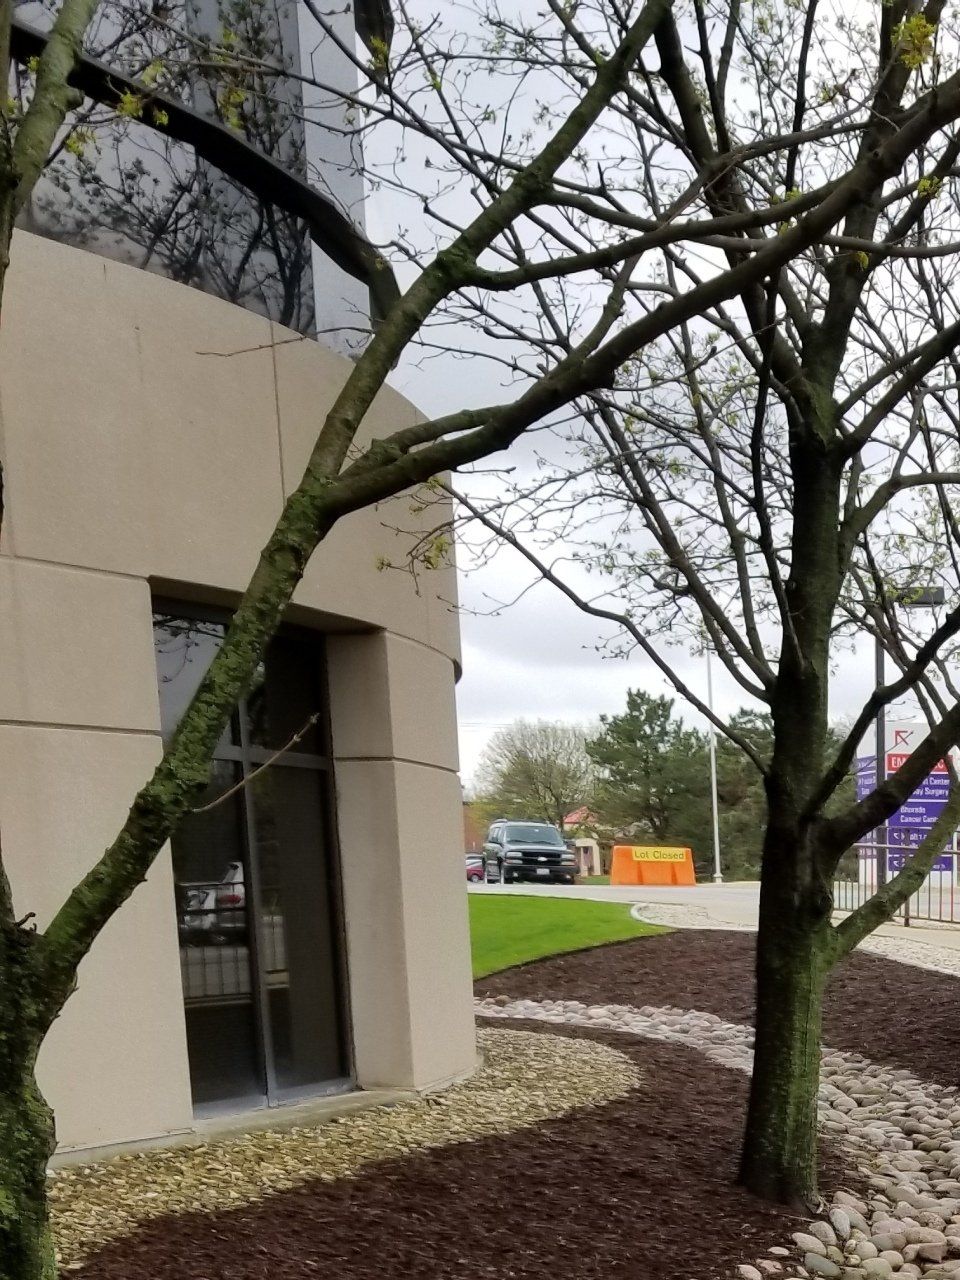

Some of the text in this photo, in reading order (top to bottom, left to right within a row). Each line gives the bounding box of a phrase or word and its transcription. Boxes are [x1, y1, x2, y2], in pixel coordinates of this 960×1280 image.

[929, 777, 950, 785] Center
[924, 787, 948, 797] Surgery
[653, 851, 684, 859] Closed
